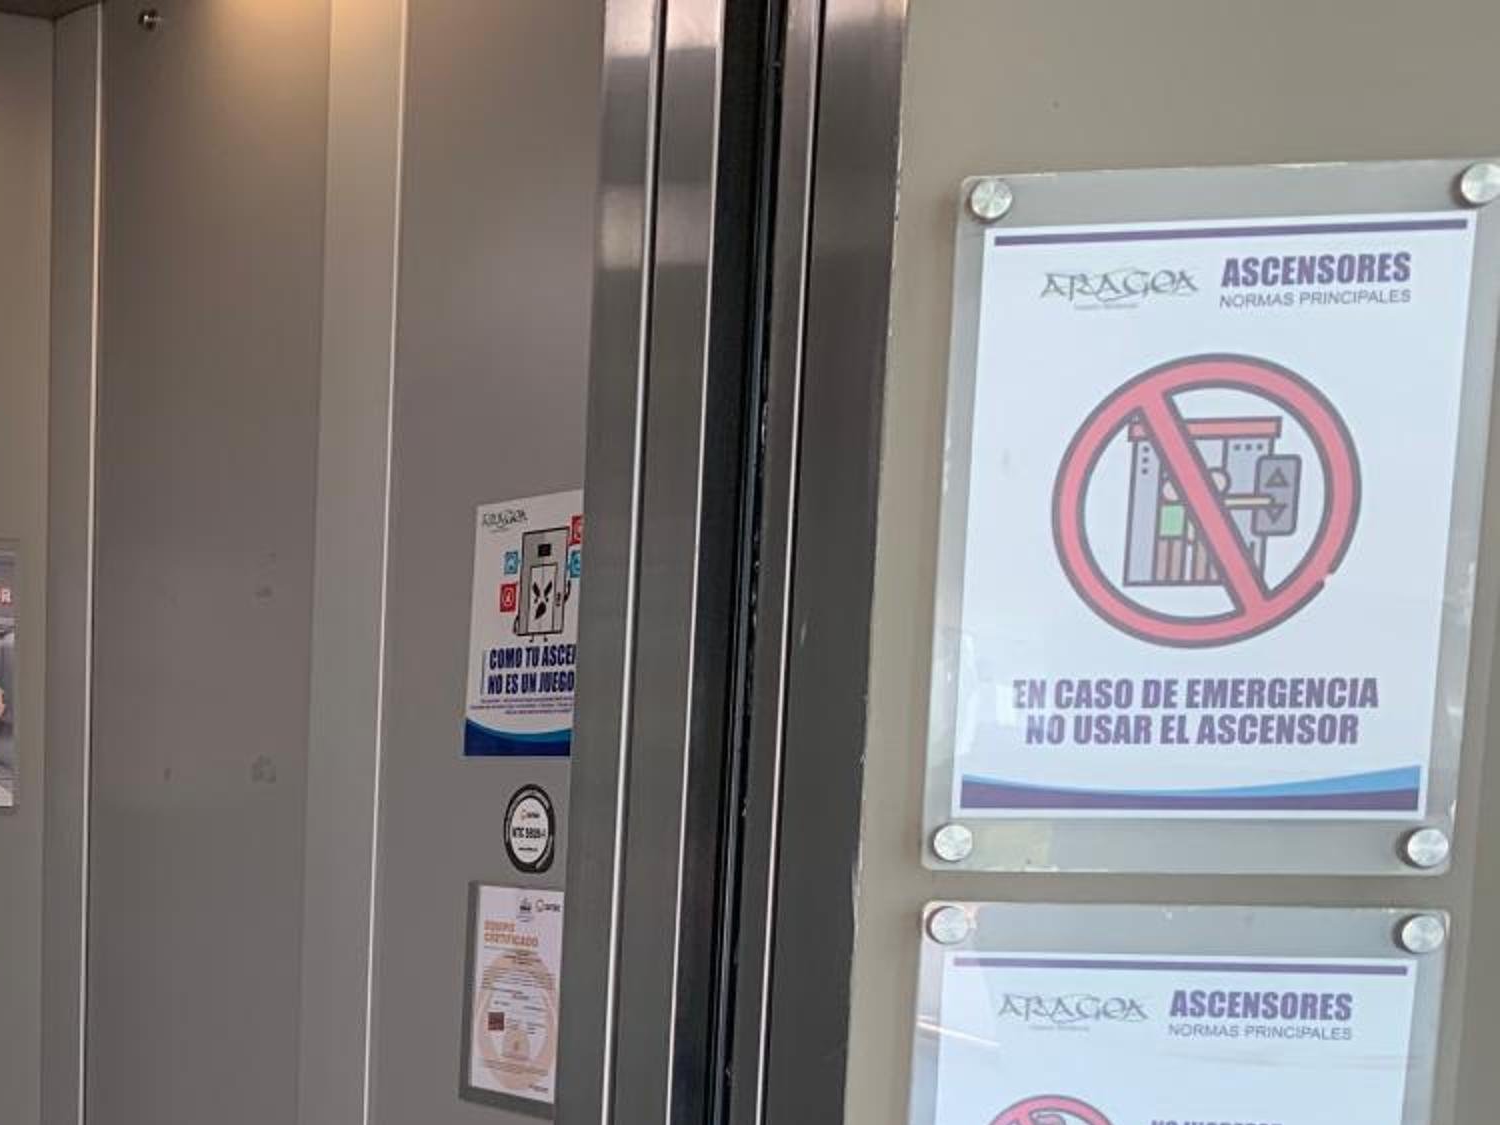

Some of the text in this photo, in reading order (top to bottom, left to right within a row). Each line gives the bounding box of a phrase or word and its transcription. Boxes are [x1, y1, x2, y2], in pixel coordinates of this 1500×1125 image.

[1040, 267, 1199, 302] ARAGOA
[1221, 252, 1412, 289] ASCENSORES
[1220, 289, 1412, 309] NORMAS PRINCIPALES
[489, 647, 523, 670] COMO
[525, 646, 540, 668] TU
[488, 670, 576, 695] NO ES UN JUEGO
[1012, 677, 1379, 709] EN CASO DE EMERGENCIA
[1025, 713, 1359, 745] NO USAR EL ASCENSOR
[998, 993, 1148, 1024] ARAGOA
[1169, 990, 1353, 1022] ASCENSORES
[1168, 1023, 1353, 1041] NORMAS PRINCIPALES
